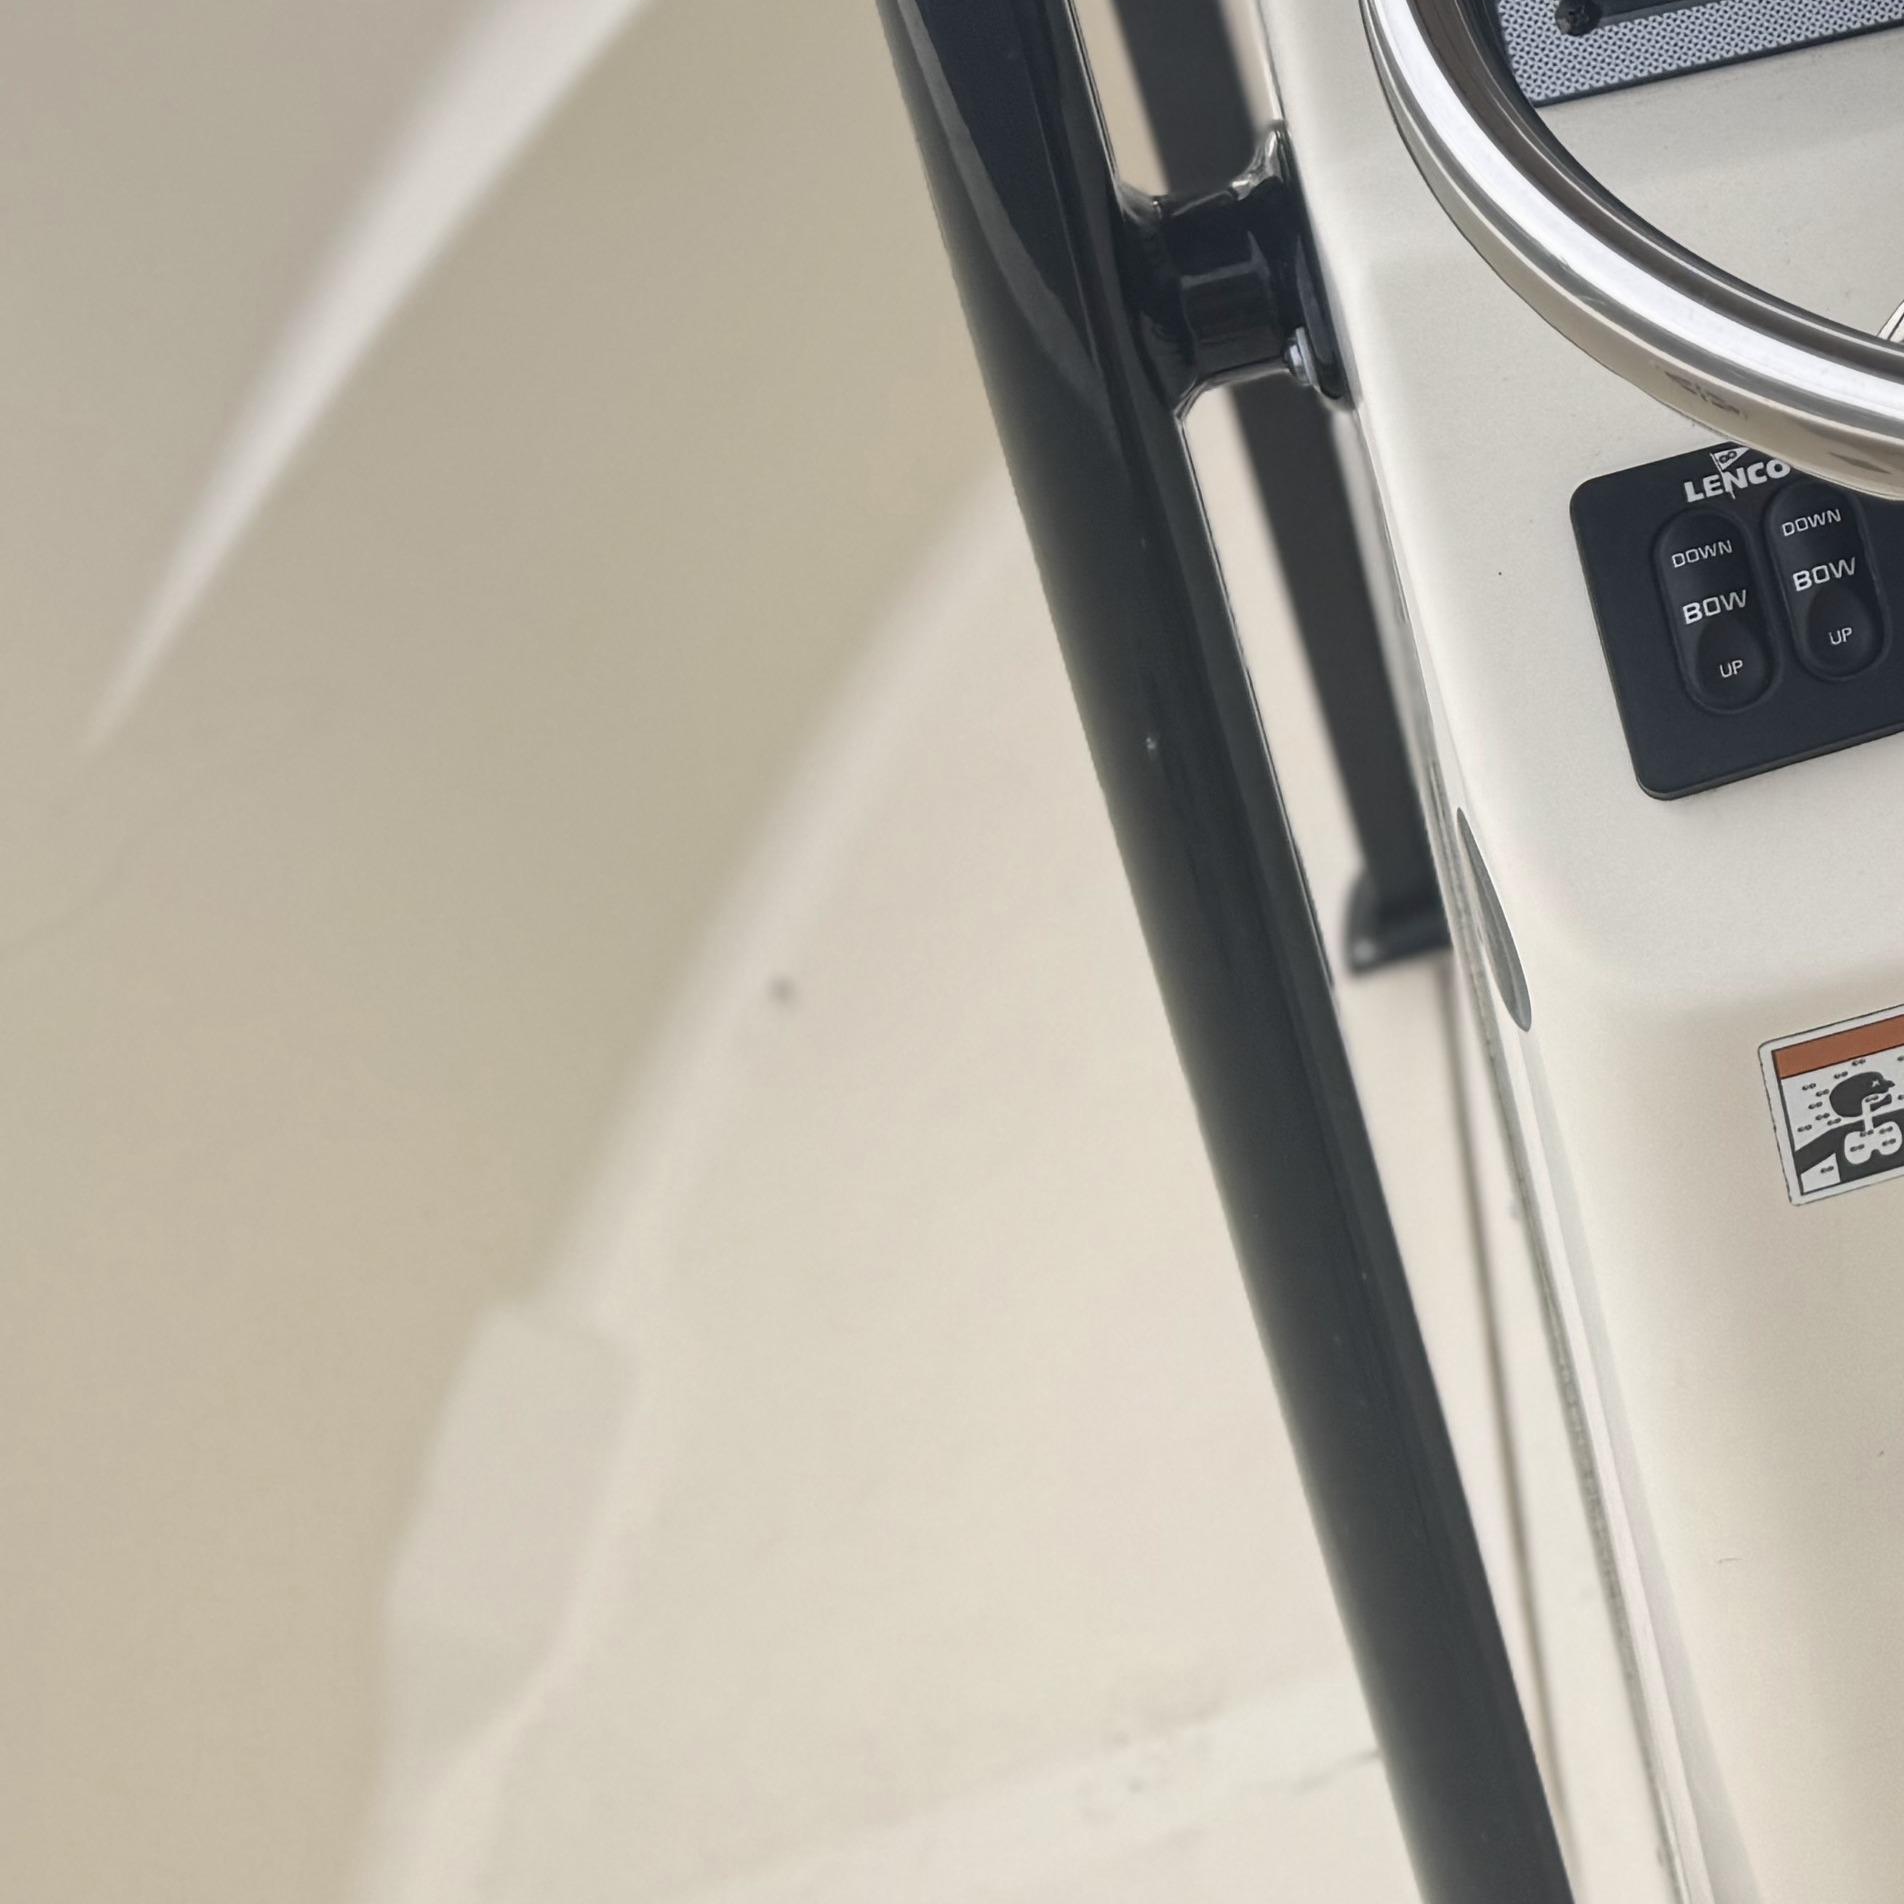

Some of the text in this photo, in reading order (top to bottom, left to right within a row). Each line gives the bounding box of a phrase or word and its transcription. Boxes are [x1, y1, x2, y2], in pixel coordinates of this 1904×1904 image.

[1683, 458, 1792, 503] LENCO
[1781, 507, 1842, 537] DOWN
[1671, 539, 1733, 569] DOWN
[1792, 557, 1857, 592] BOW
[1682, 589, 1748, 625] BOW
[1829, 627, 1853, 646] UP
[1719, 659, 1744, 678] UP
